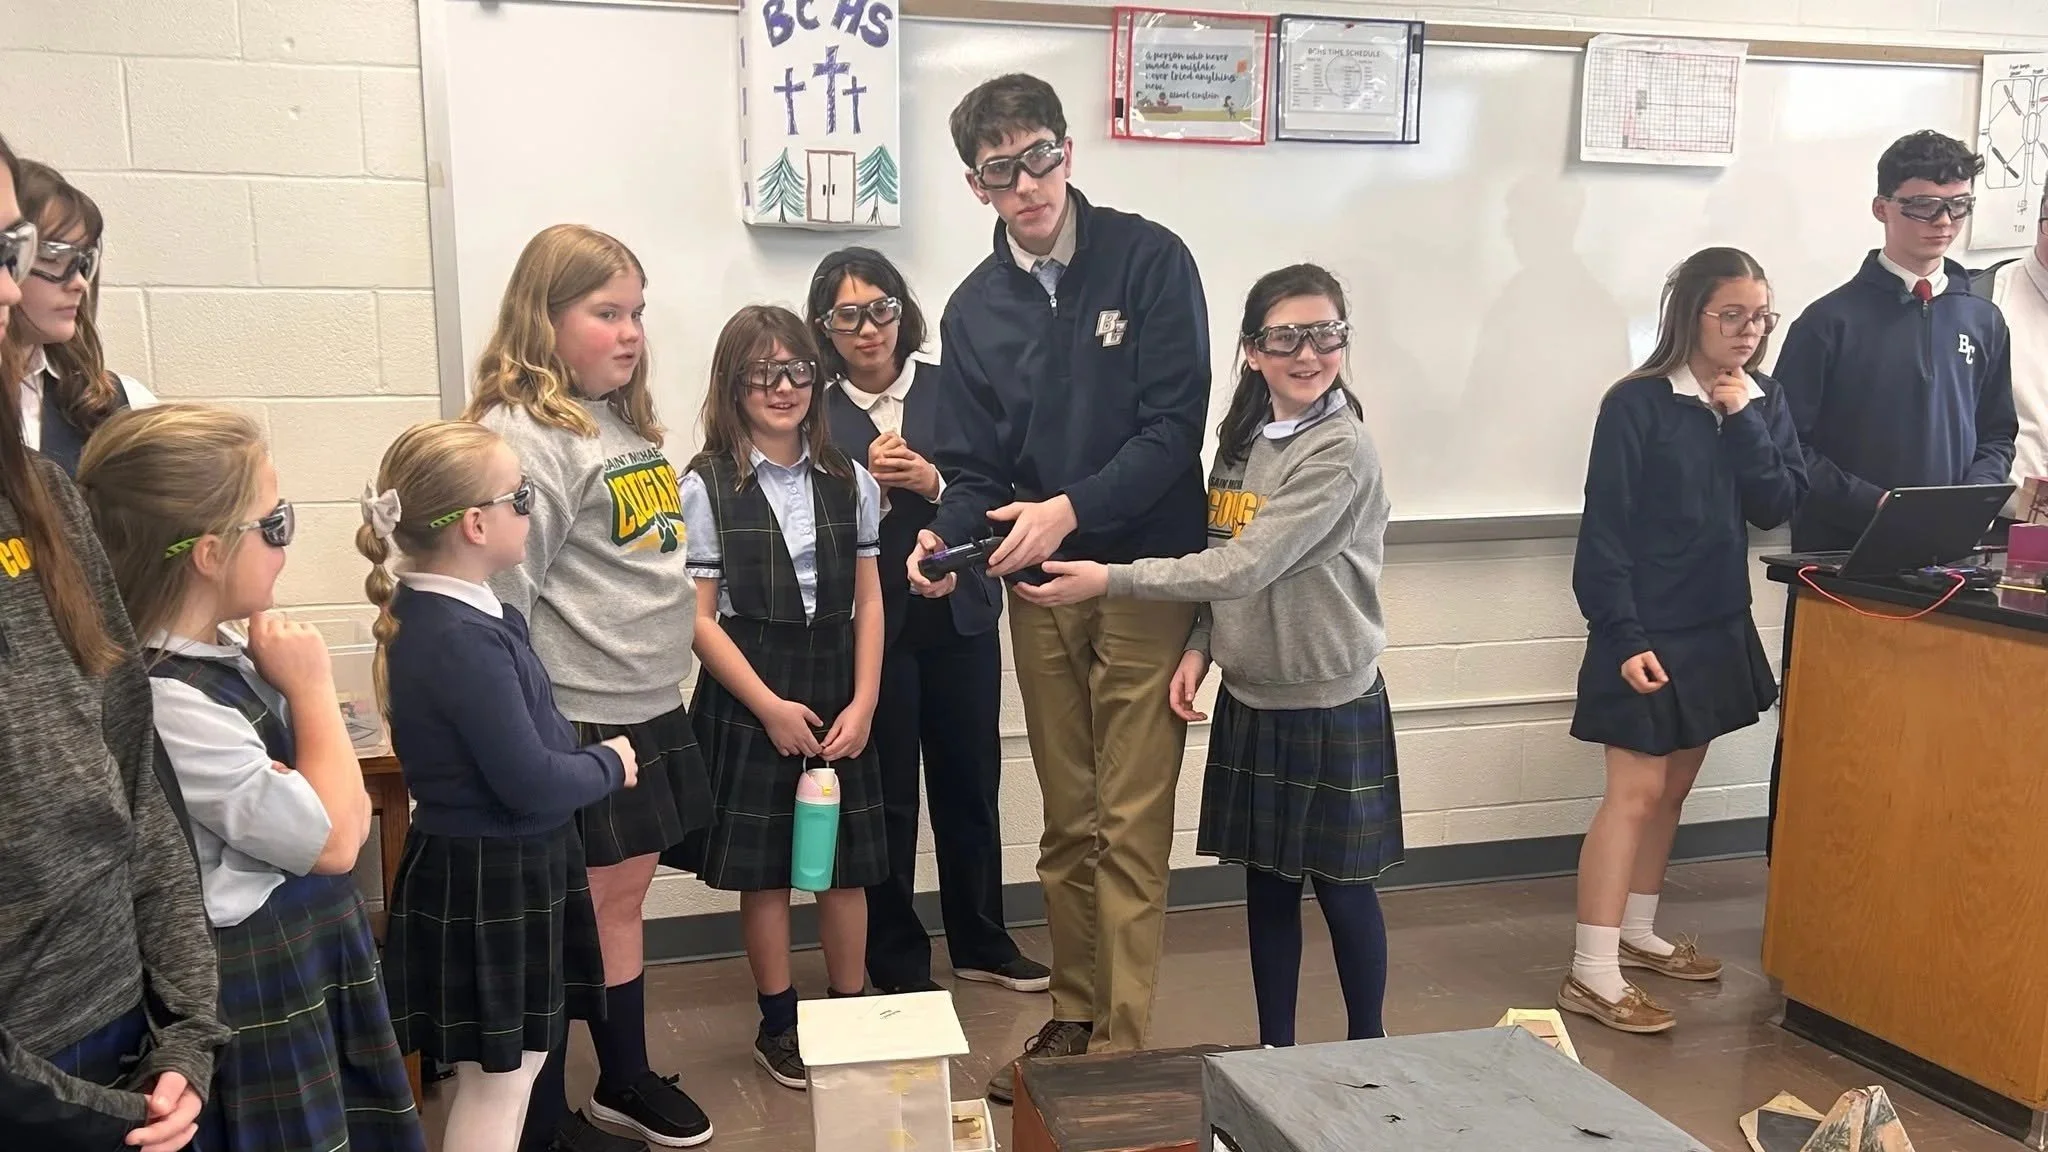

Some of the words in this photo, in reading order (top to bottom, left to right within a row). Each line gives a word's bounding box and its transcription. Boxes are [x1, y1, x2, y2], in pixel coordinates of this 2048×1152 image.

[1153, 52, 1184, 61] person
[1186, 52, 1203, 60] who
[1205, 53, 1229, 61] never
[1344, 49, 1381, 58] SCHEDULE
[1145, 61, 1170, 70] made
[1180, 61, 1216, 72] mistake
[1170, 72, 1193, 81] tried
[1194, 72, 1236, 84] anything
[1095, 309, 1128, 347] BC
[1958, 333, 1976, 365] BC
